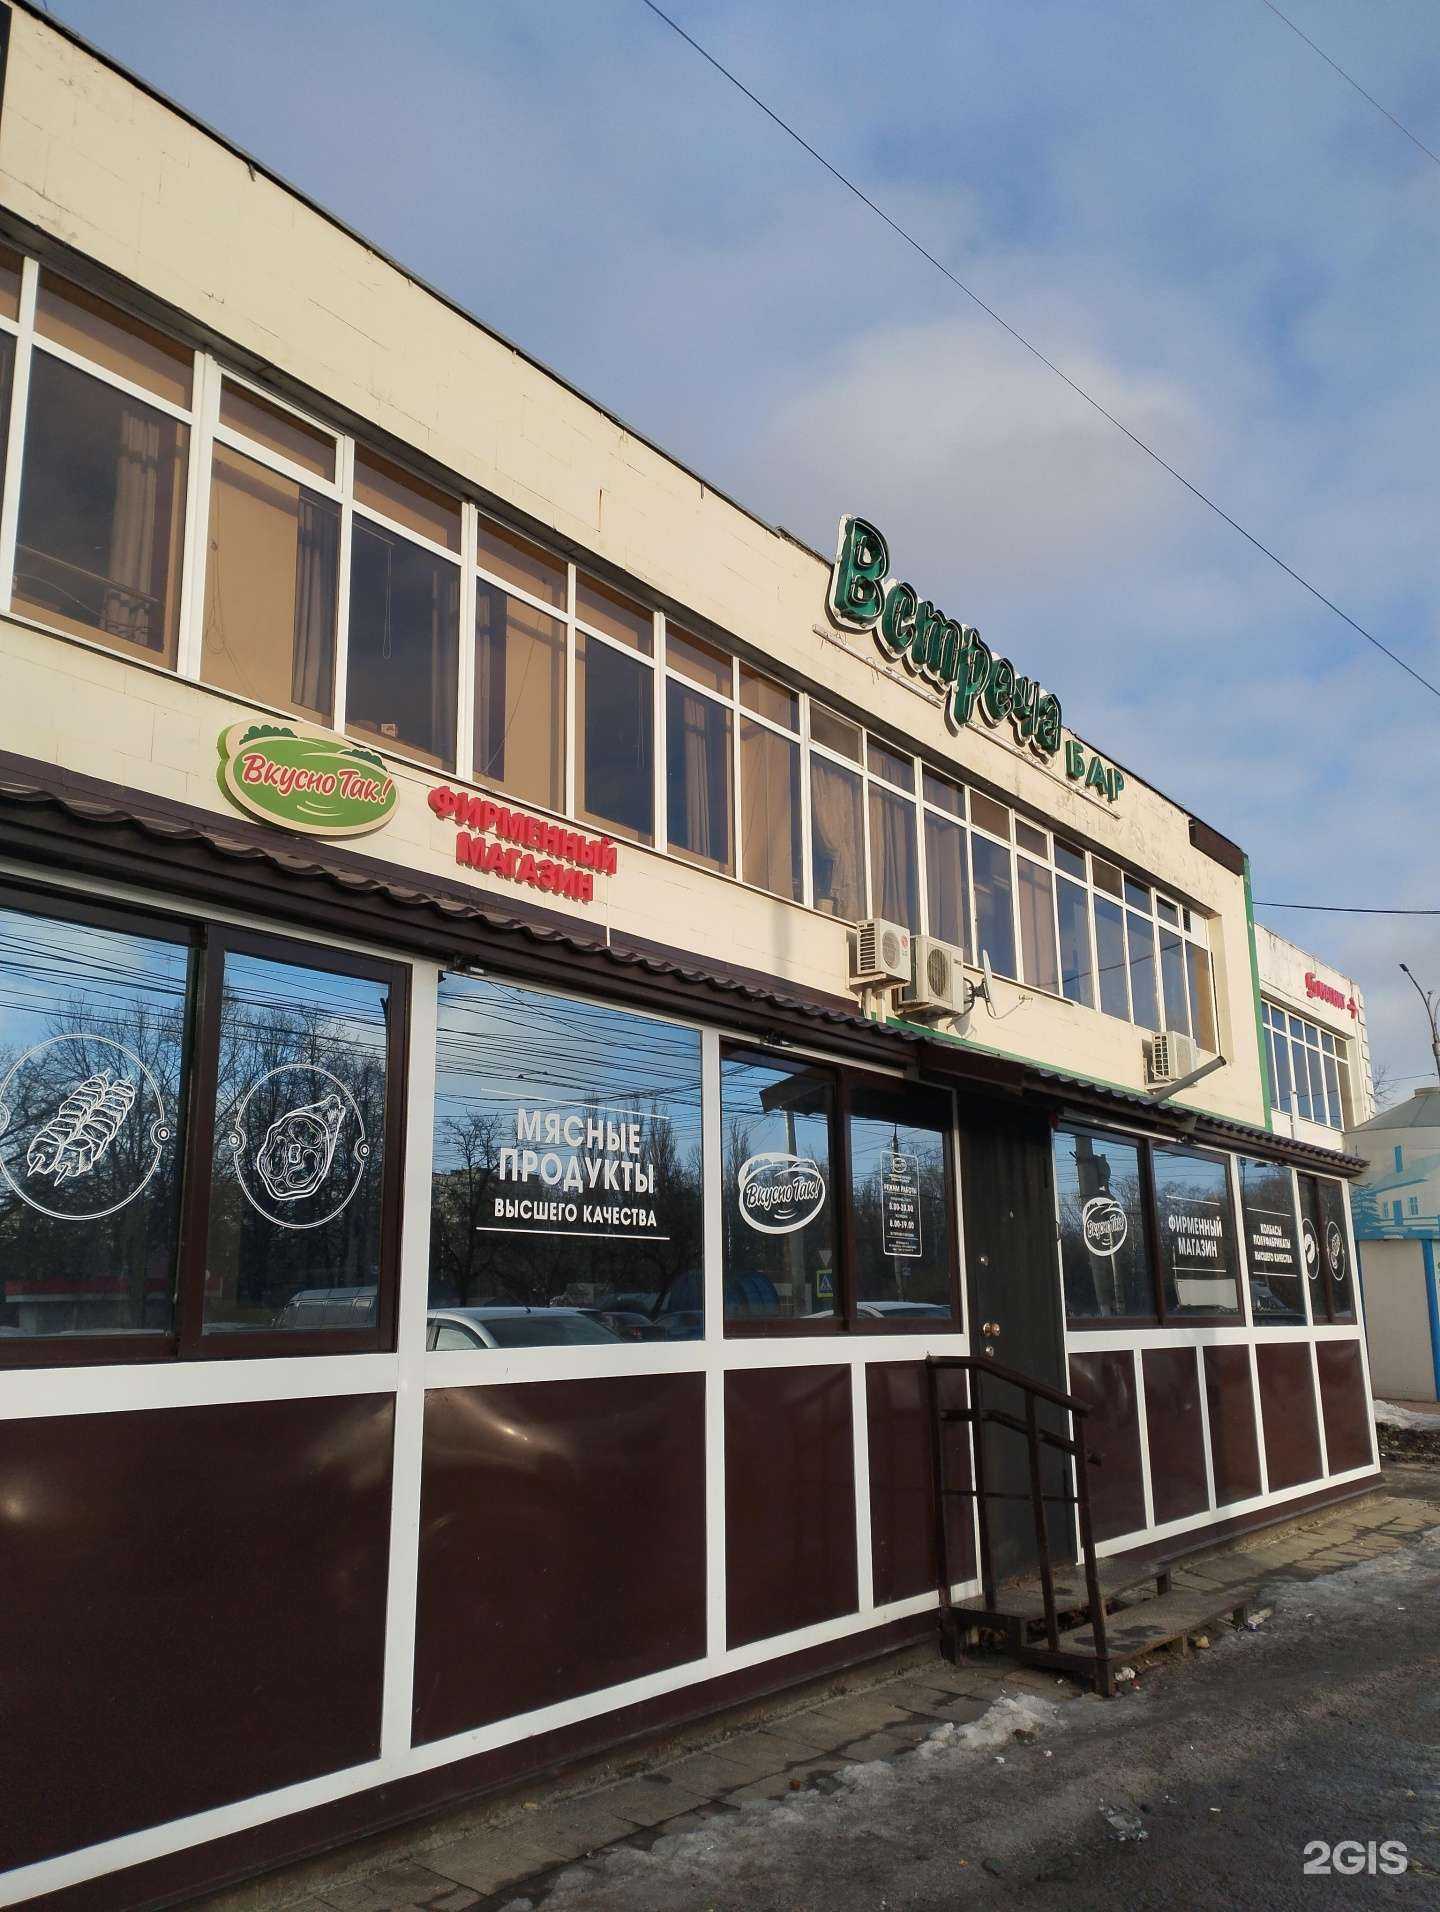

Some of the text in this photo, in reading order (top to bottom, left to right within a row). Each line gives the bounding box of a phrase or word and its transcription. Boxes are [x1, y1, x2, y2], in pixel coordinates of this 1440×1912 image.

[825, 513, 1125, 801] Встреча БАР
[243, 753, 393, 805] Вкусно Так!
[427, 785, 618, 877] ФИРМЕННЫЙ
[456, 831, 594, 904] МАГАЗИН
[517, 1108, 640, 1154] МЯСНЫЕ
[499, 1147, 654, 1194] ПРОДУКТЫ
[494, 1198, 657, 1227] ВЫСШЕГО КАЧЕСТВА
[746, 1183, 793, 1211] Вкусно
[1168, 1214, 1223, 1238] ФИРМЕННЫЙ
[1178, 1237, 1218, 1258] МАГАЗИН
